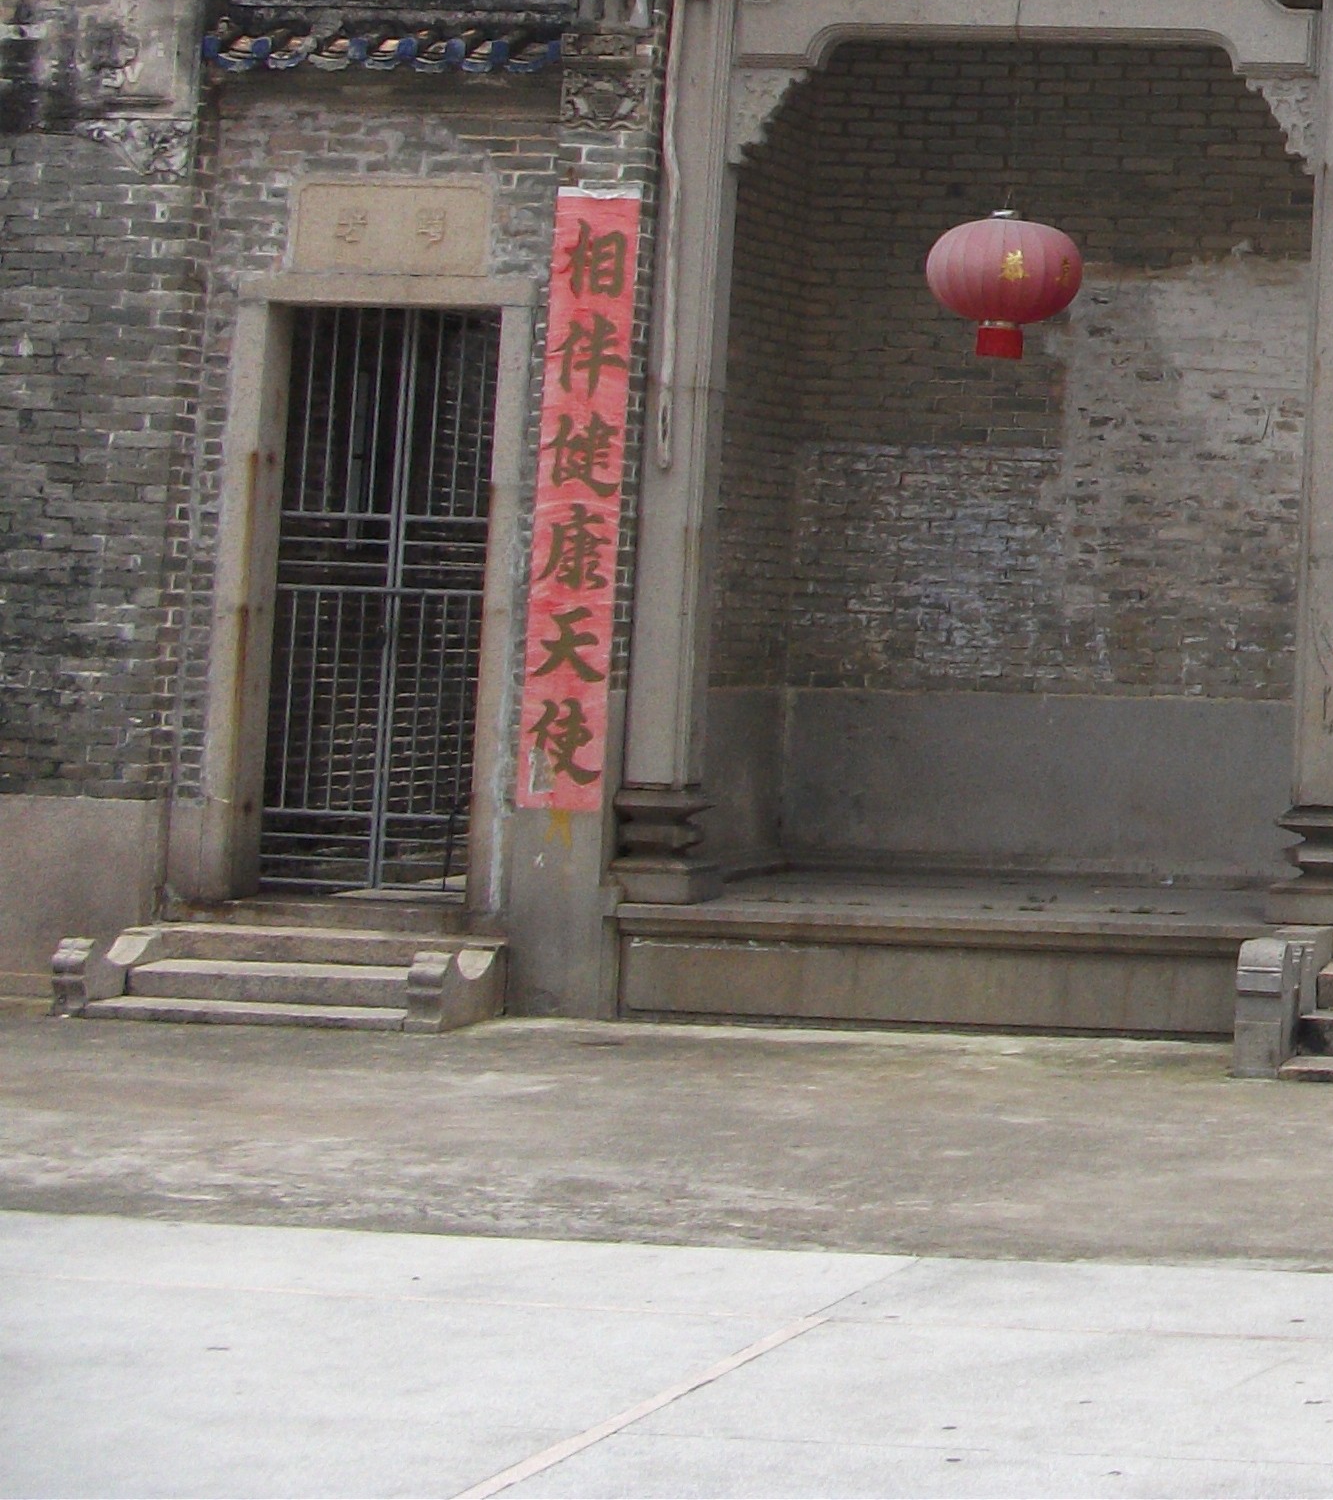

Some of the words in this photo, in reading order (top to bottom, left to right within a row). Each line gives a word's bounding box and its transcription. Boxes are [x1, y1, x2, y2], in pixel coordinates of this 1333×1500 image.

[528, 217, 628, 787] 相伴健康天使
